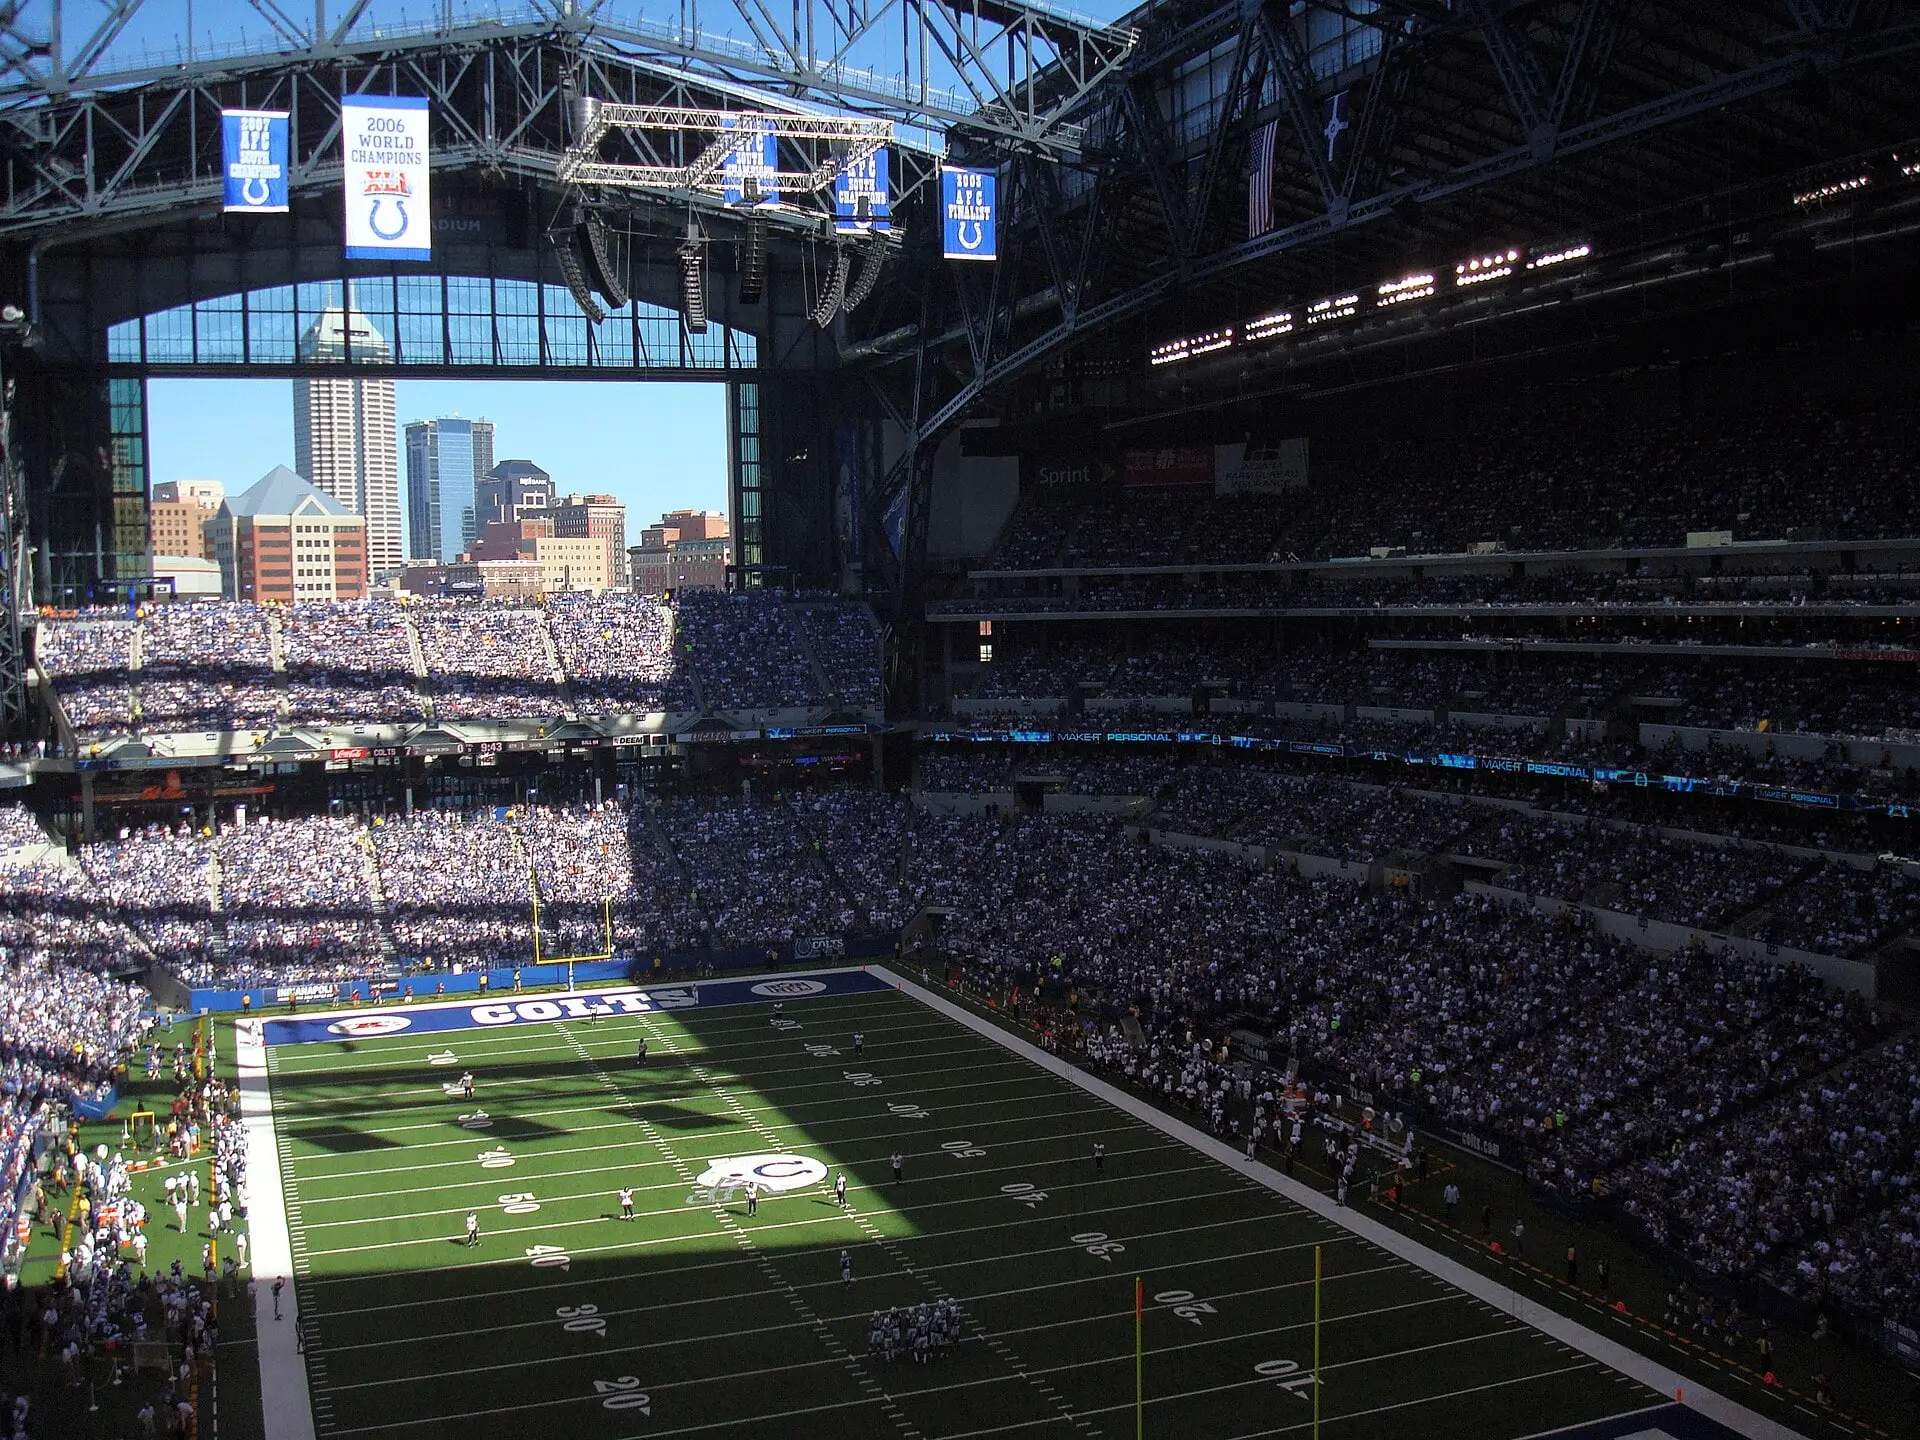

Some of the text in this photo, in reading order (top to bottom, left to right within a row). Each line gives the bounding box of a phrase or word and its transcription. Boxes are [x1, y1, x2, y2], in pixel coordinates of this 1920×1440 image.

[241, 117, 270, 131] 2007
[367, 117, 405, 132] 2006
[241, 131, 270, 150] AFC
[359, 134, 414, 149] WORLD
[351, 149, 421, 165] CHAMPIONS
[956, 190, 983, 205] AFC
[948, 204, 991, 220] FINALIST
[1039, 465, 1091, 488] Sprint
[825, 726, 862, 734] PERSONAL
[1057, 733, 1092, 741] MAKE
[1107, 733, 1173, 741] PERSONAL
[481, 742, 502, 752] 9:43
[620, 736, 644, 744] DEEM
[373, 748, 396, 756] COLTS
[404, 746, 412, 756] 7
[457, 744, 464, 753] 0
[1481, 759, 1511, 772] MAKE
[1527, 763, 1589, 778] PERSONAL
[1790, 793, 1834, 805] PERSONAL
[470, 990, 698, 1025] COLTS
[846, 1072, 883, 1087] 30
[890, 1104, 930, 1119] 40
[457, 1113, 494, 1128] 30
[941, 1140, 987, 1160] 50
[477, 1151, 516, 1168] 40
[1001, 1183, 1049, 1202] 40
[498, 1192, 541, 1214] 50
[1070, 1232, 1126, 1256] 30
[526, 1245, 571, 1267] 40
[1154, 1290, 1218, 1319] 20
[556, 1304, 606, 1331] 30
[1254, 1360, 1324, 1390] 10
[593, 1376, 651, 1409] 20
